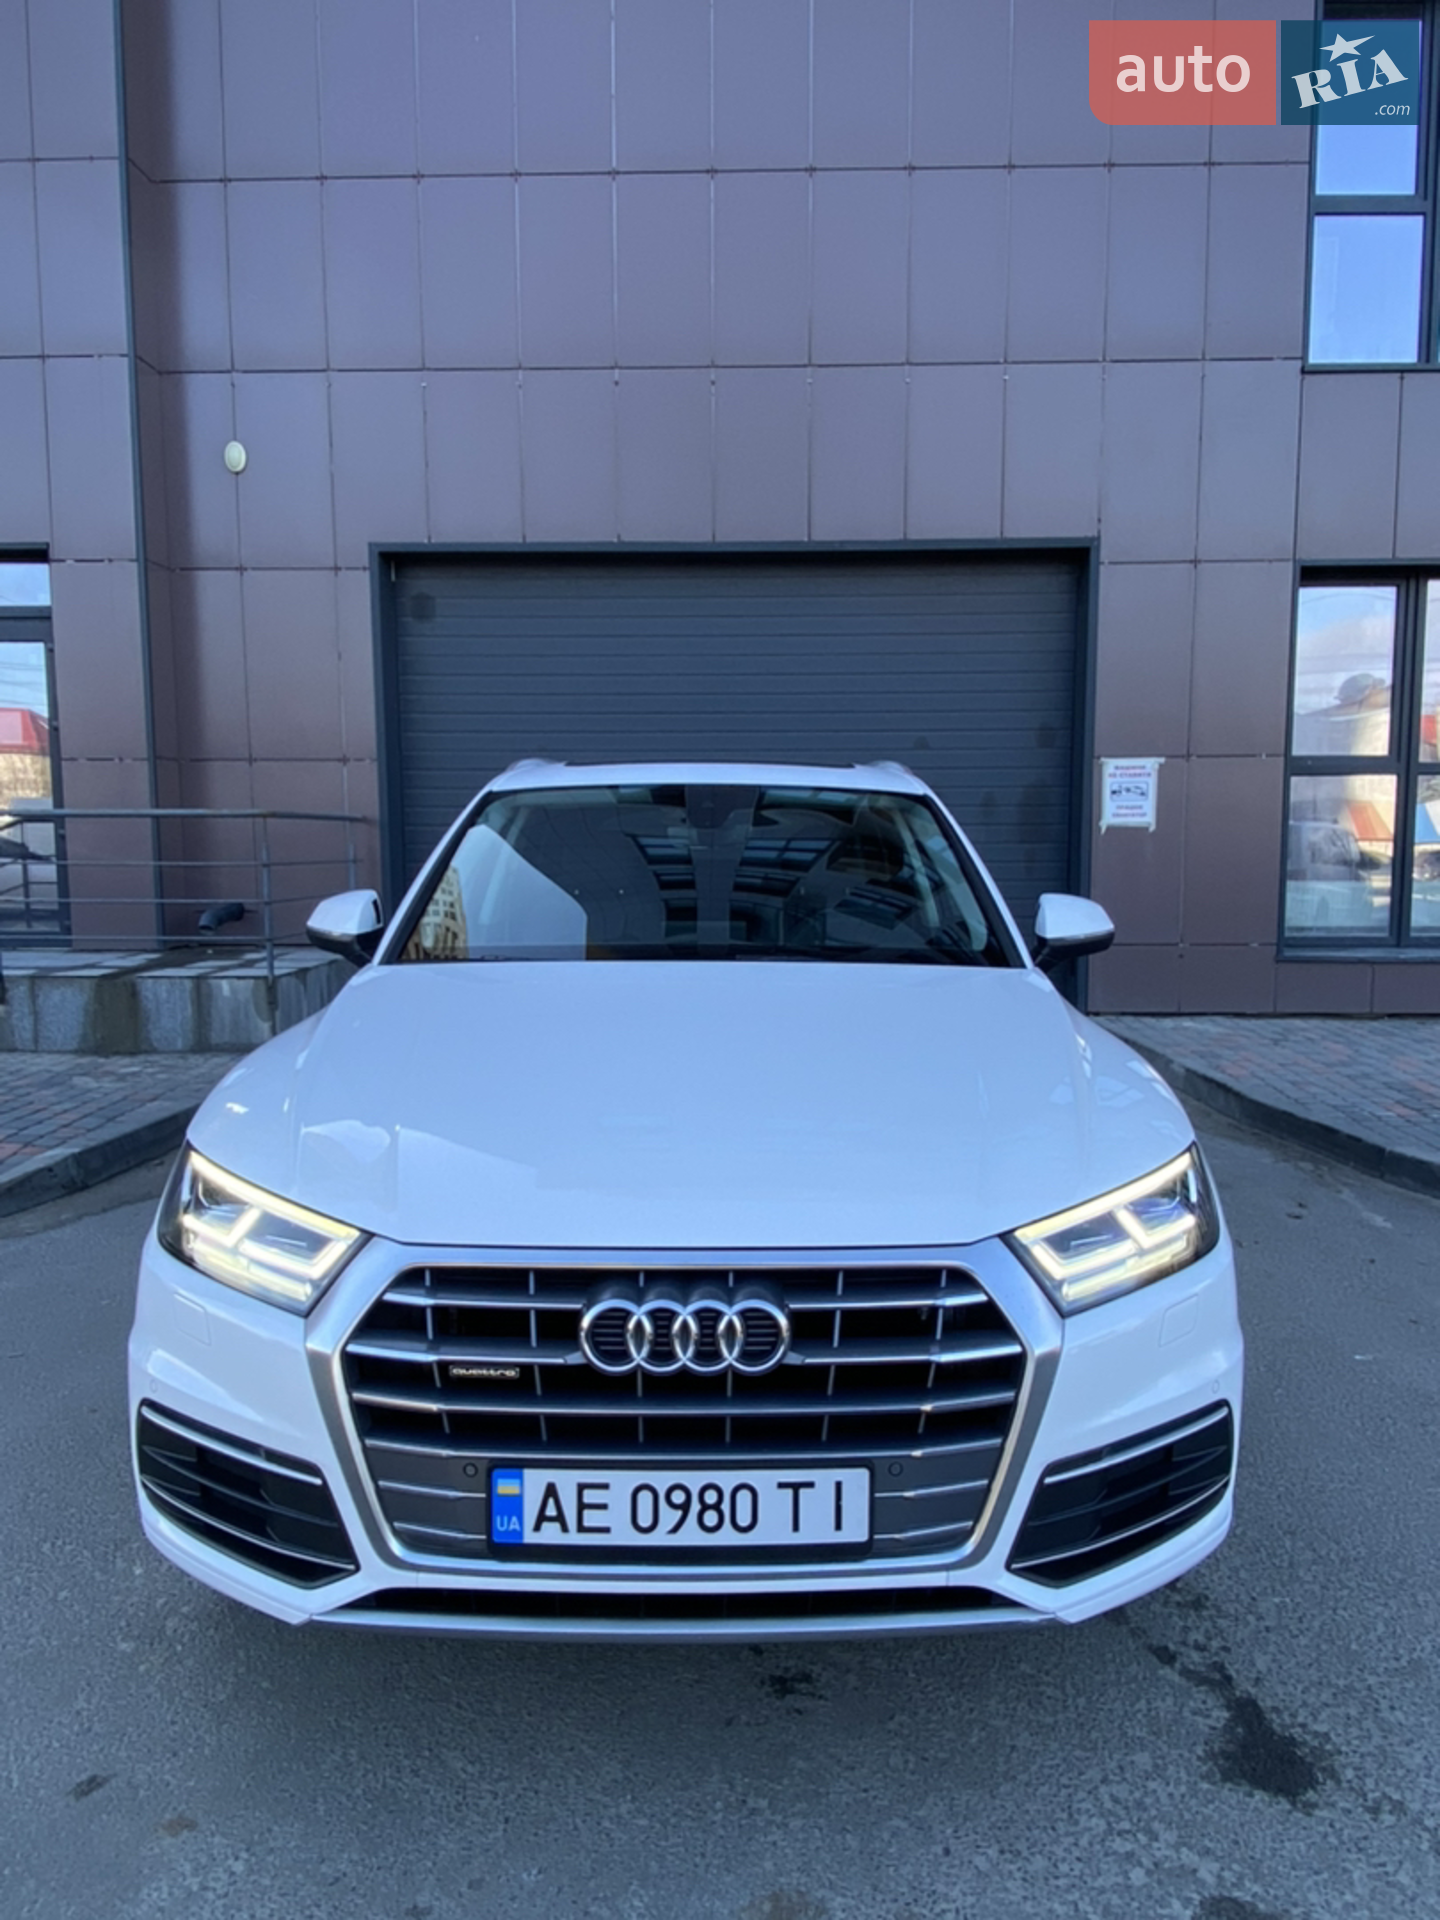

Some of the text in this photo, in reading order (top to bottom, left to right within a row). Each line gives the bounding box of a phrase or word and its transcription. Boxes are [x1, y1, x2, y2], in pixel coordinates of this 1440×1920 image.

[452, 1367, 516, 1377] quattro
[532, 1481, 612, 1533] AE
[629, 1482, 760, 1535] 0980
[496, 1515, 522, 1532] UA
